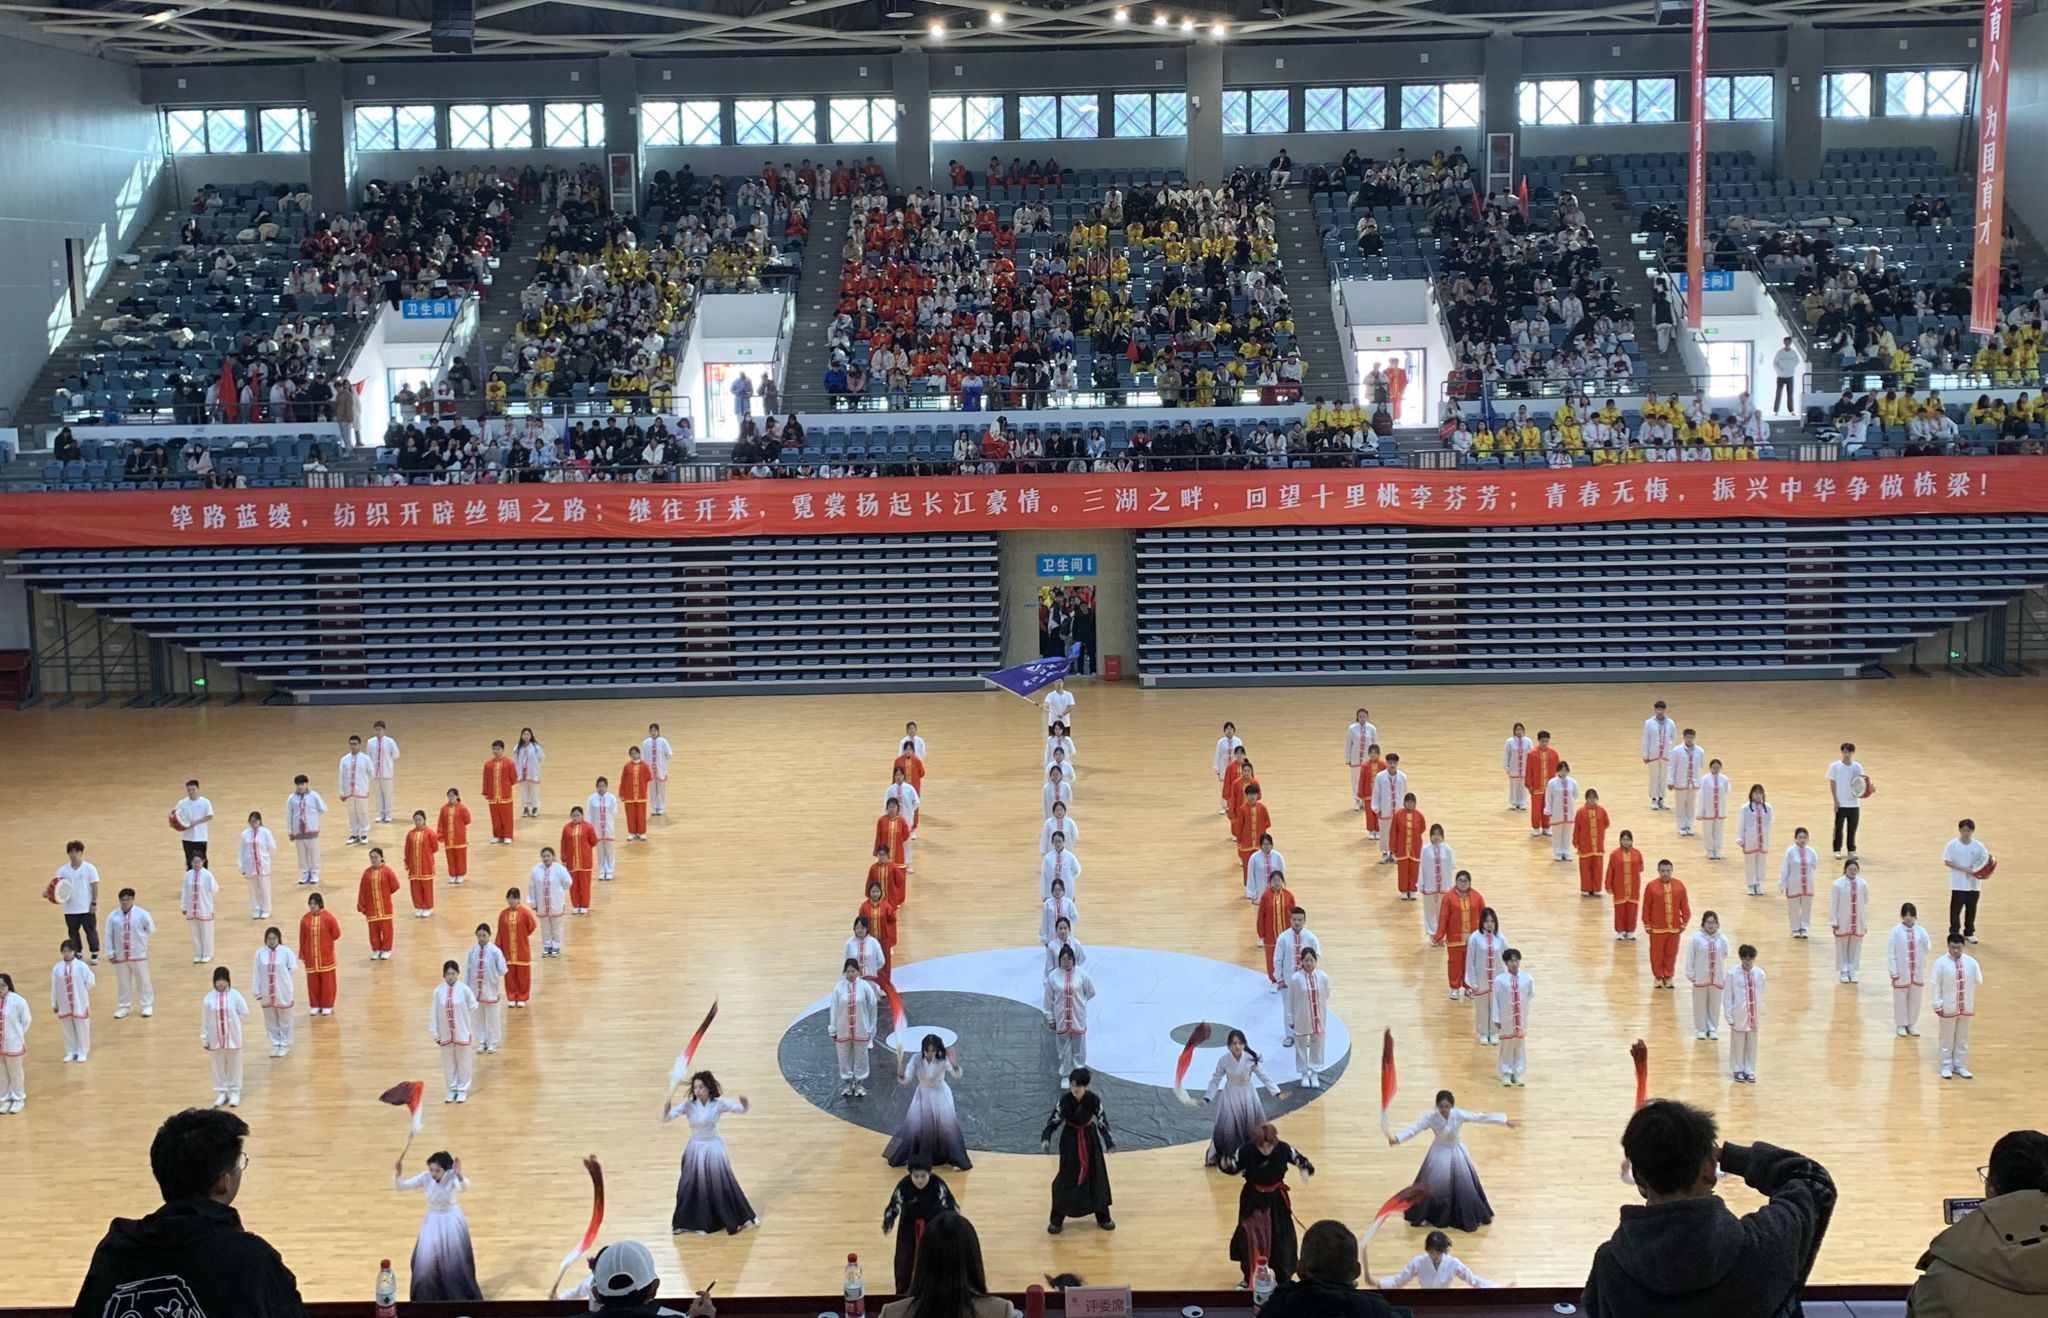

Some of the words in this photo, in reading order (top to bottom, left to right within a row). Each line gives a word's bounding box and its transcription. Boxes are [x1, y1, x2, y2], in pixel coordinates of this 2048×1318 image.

[1986, 0, 2003, 79] 育人
[1980, 105, 1998, 245] 为国育才
[407, 303, 446, 316] 卫生间
[1043, 557, 1084, 572] 卫生间
[1085, 1299, 1126, 1313] 评委席
